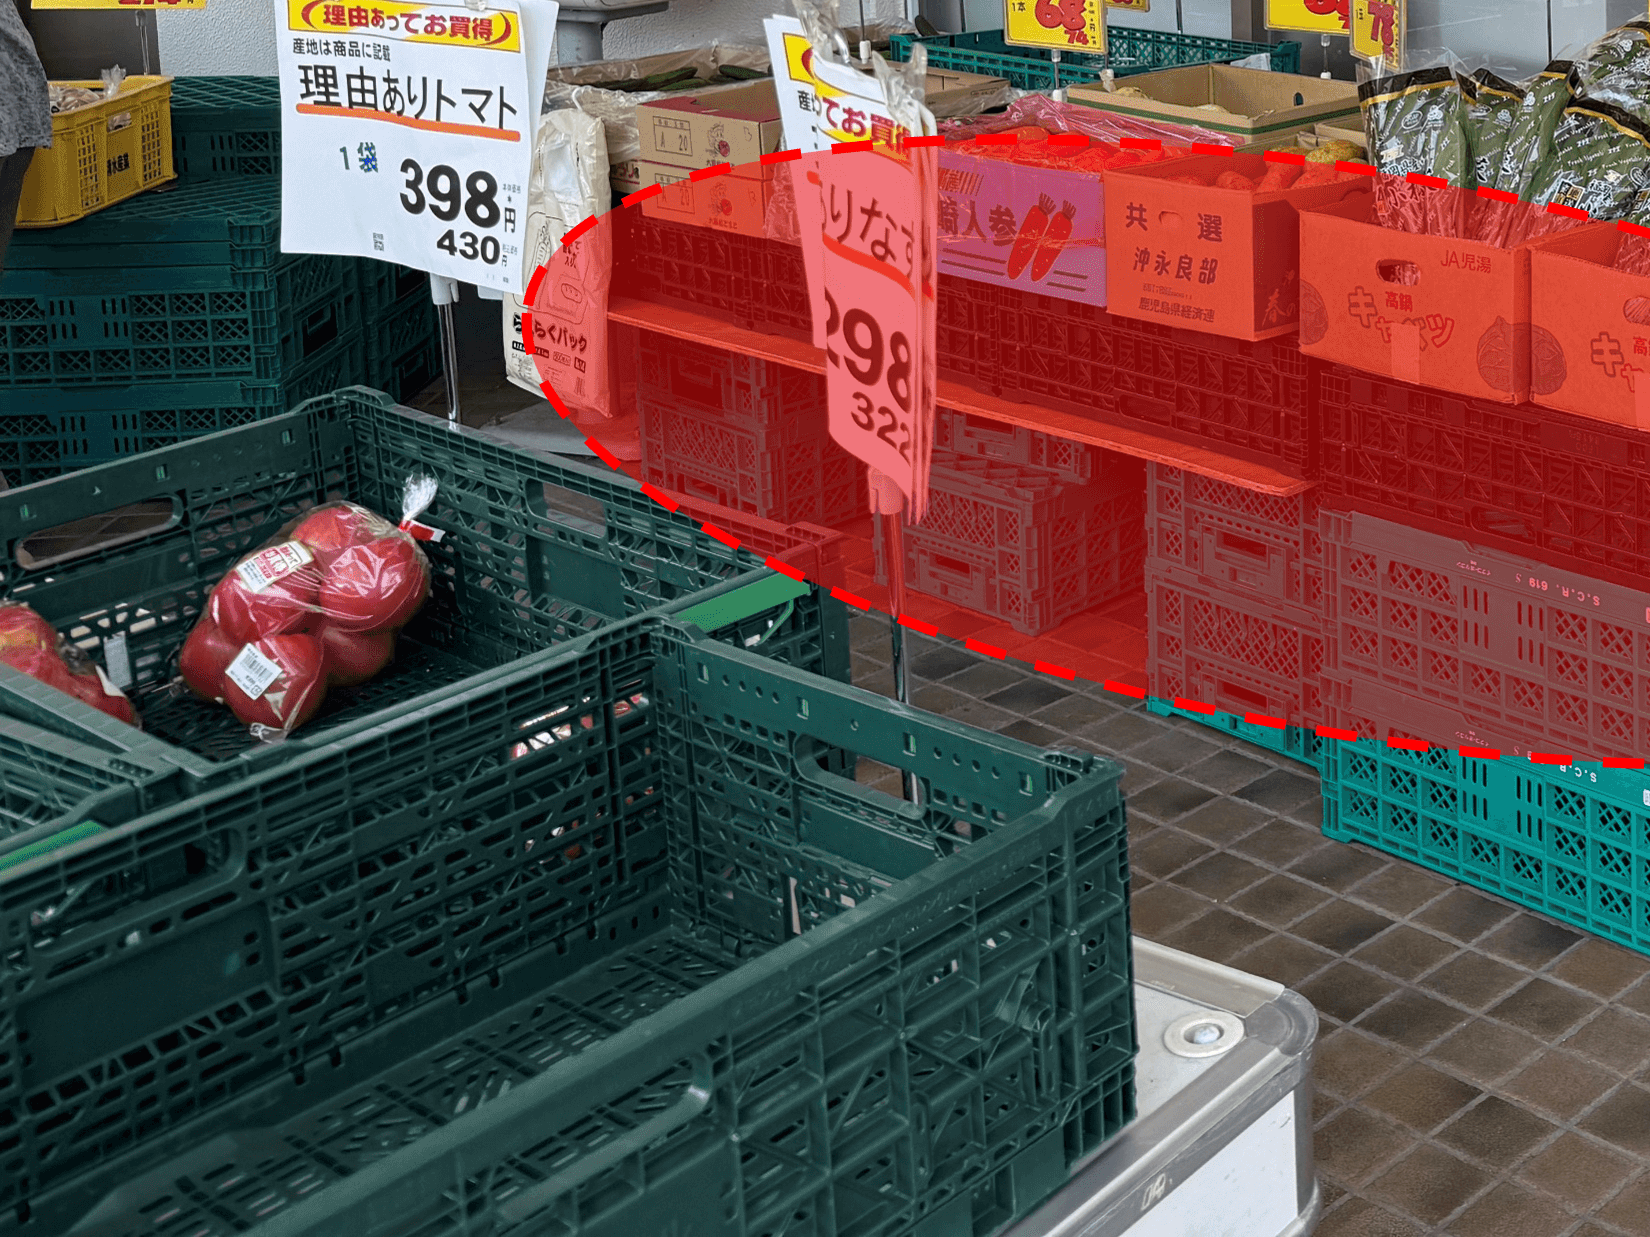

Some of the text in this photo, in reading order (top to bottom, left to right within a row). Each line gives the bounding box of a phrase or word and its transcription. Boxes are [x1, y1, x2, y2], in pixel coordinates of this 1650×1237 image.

[323, 4, 494, 41] 理由あってお買得
[1011, 2, 1026, 13] 1本
[1368, 0, 1394, 45] 78
[292, 37, 391, 62] 産地は商品に記載
[1064, 30, 1089, 45] 74
[298, 64, 517, 129] 理由ありトマト
[339, 142, 379, 173] 1袋
[679, 134, 688, 151] 20
[400, 158, 500, 228] 398
[503, 207, 516, 234] 円
[821, 188, 915, 278] りなす
[436, 229, 500, 265] 430
[1440, 250, 1492, 273] JA児湯
[1132, 246, 1220, 286] 沖永良部
[1138, 296, 1216, 324] 鹿児島県経済連
[1384, 291, 1413, 312] 高鍋
[512, 312, 587, 355] ららくパック
[850, 391, 911, 468] 322
[1556, 583, 1600, 606] S.C.R.
